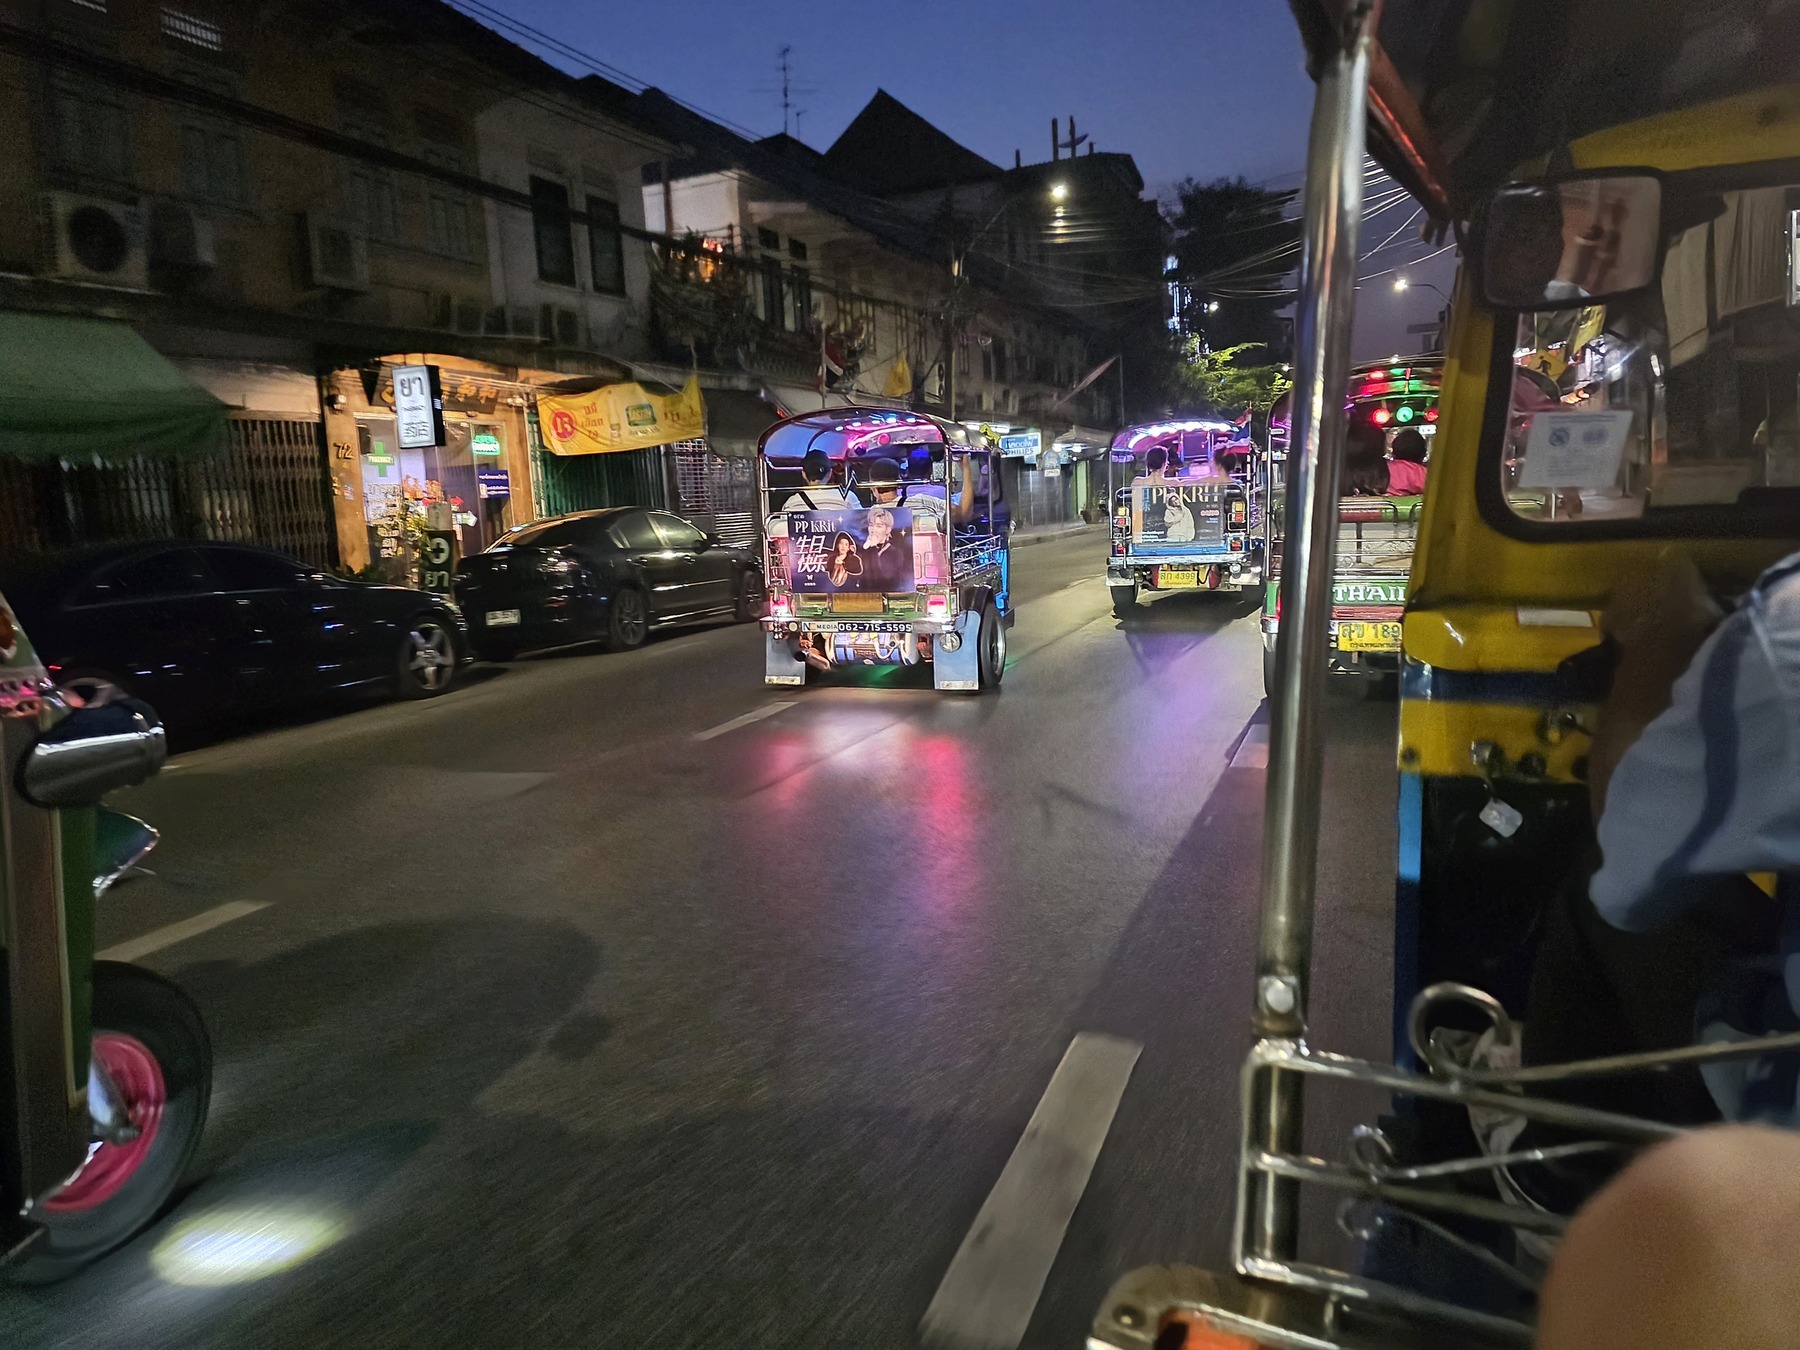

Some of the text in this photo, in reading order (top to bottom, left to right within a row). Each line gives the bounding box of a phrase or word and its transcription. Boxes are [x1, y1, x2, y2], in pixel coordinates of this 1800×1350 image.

[400, 376, 425, 397] ยา
[333, 443, 353, 460] 72
[795, 520, 809, 533] PP
[794, 535, 826, 554] 生日
[797, 553, 829, 573] 快乐
[424, 570, 449, 588] ยา
[1175, 572, 1196, 580] 4399
[838, 623, 912, 632] 062-715-5595
